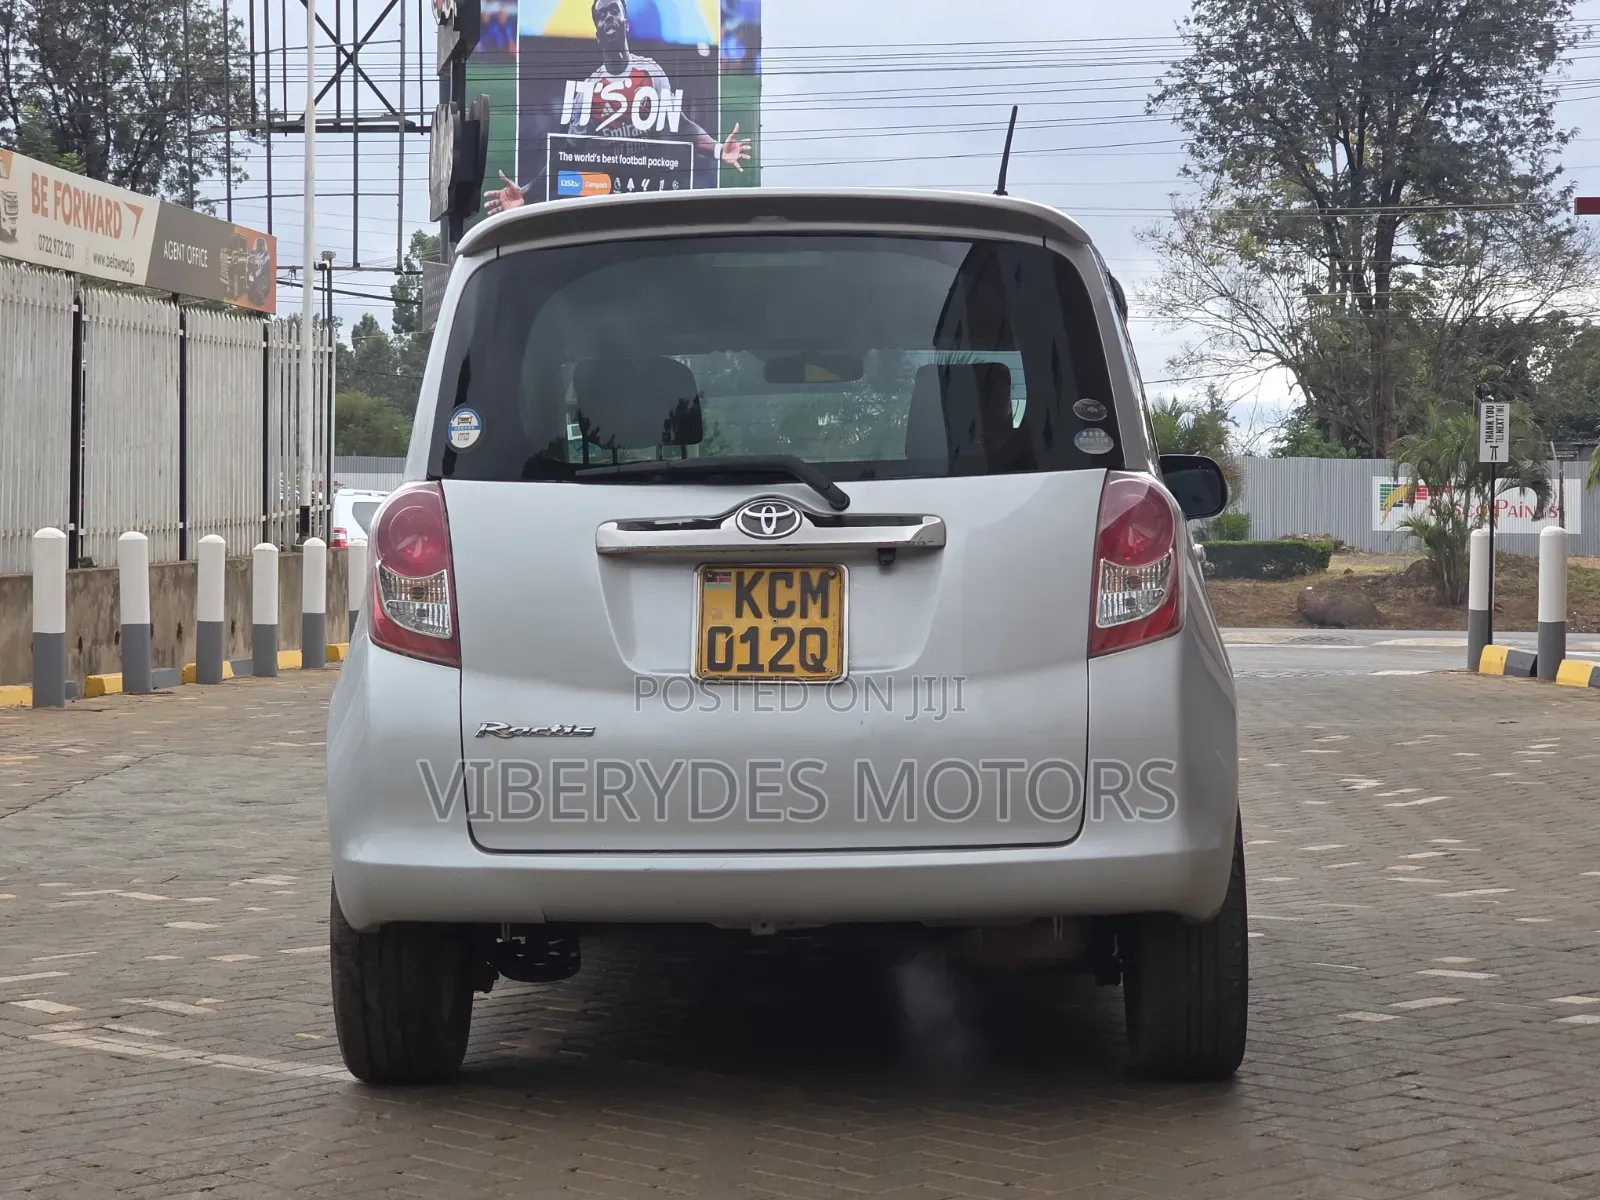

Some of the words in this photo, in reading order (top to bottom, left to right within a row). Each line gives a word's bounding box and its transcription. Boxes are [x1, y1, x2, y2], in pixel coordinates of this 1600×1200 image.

[631, 86, 684, 132] ON
[559, 152, 573, 162] The
[574, 153, 601, 163] world's
[602, 154, 618, 164] best
[619, 155, 647, 166] football
[648, 158, 679, 170] package
[584, 181, 608, 189] Compact
[31, 172, 49, 218] BE
[53, 179, 123, 239] FORWARD
[37, 233, 52, 254] 0722
[53, 238, 64, 257] 972
[64, 241, 75, 260] 201
[163, 240, 184, 262] AGENT
[187, 246, 208, 268] OFFICE
[1485, 405, 1494, 419] YOU
[1495, 404, 1505, 417] TIME
[1485, 420, 1494, 444] THANK
[1495, 417, 1504, 433] NEXT
[735, 571, 829, 619] KCM
[707, 625, 828, 673] 012Q
[474, 720, 597, 739] Ractis
